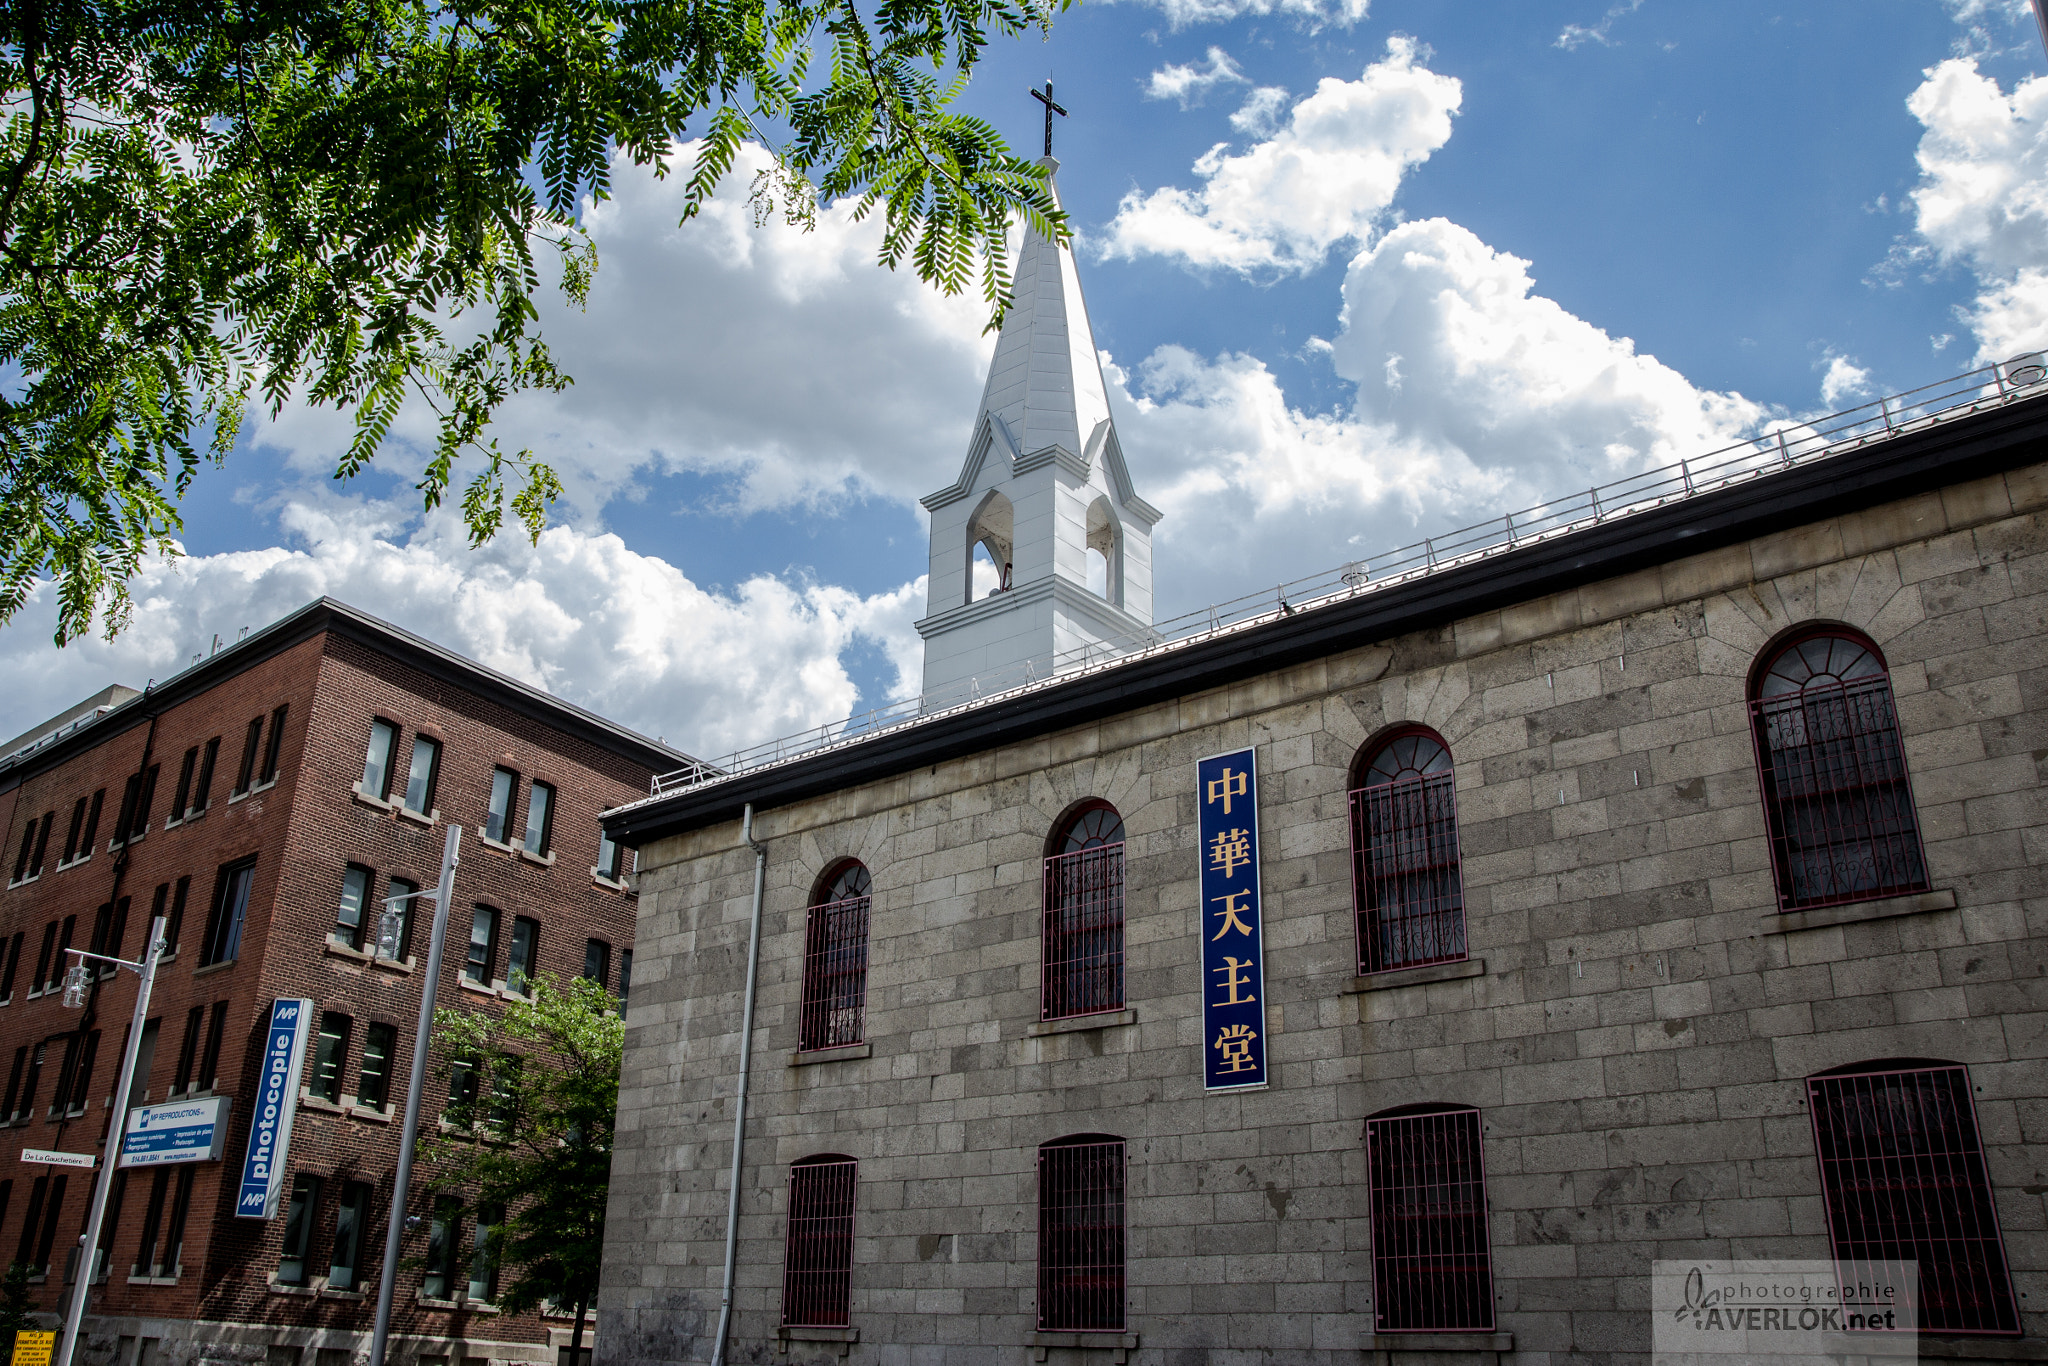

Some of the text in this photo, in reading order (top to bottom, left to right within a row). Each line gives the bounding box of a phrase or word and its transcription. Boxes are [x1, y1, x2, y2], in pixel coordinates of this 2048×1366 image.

[1207, 767, 1258, 1076] 中華天主堂
[159, 1108, 201, 1121] REPRODUCTIONS
[252, 1034, 290, 1179] photocopie
